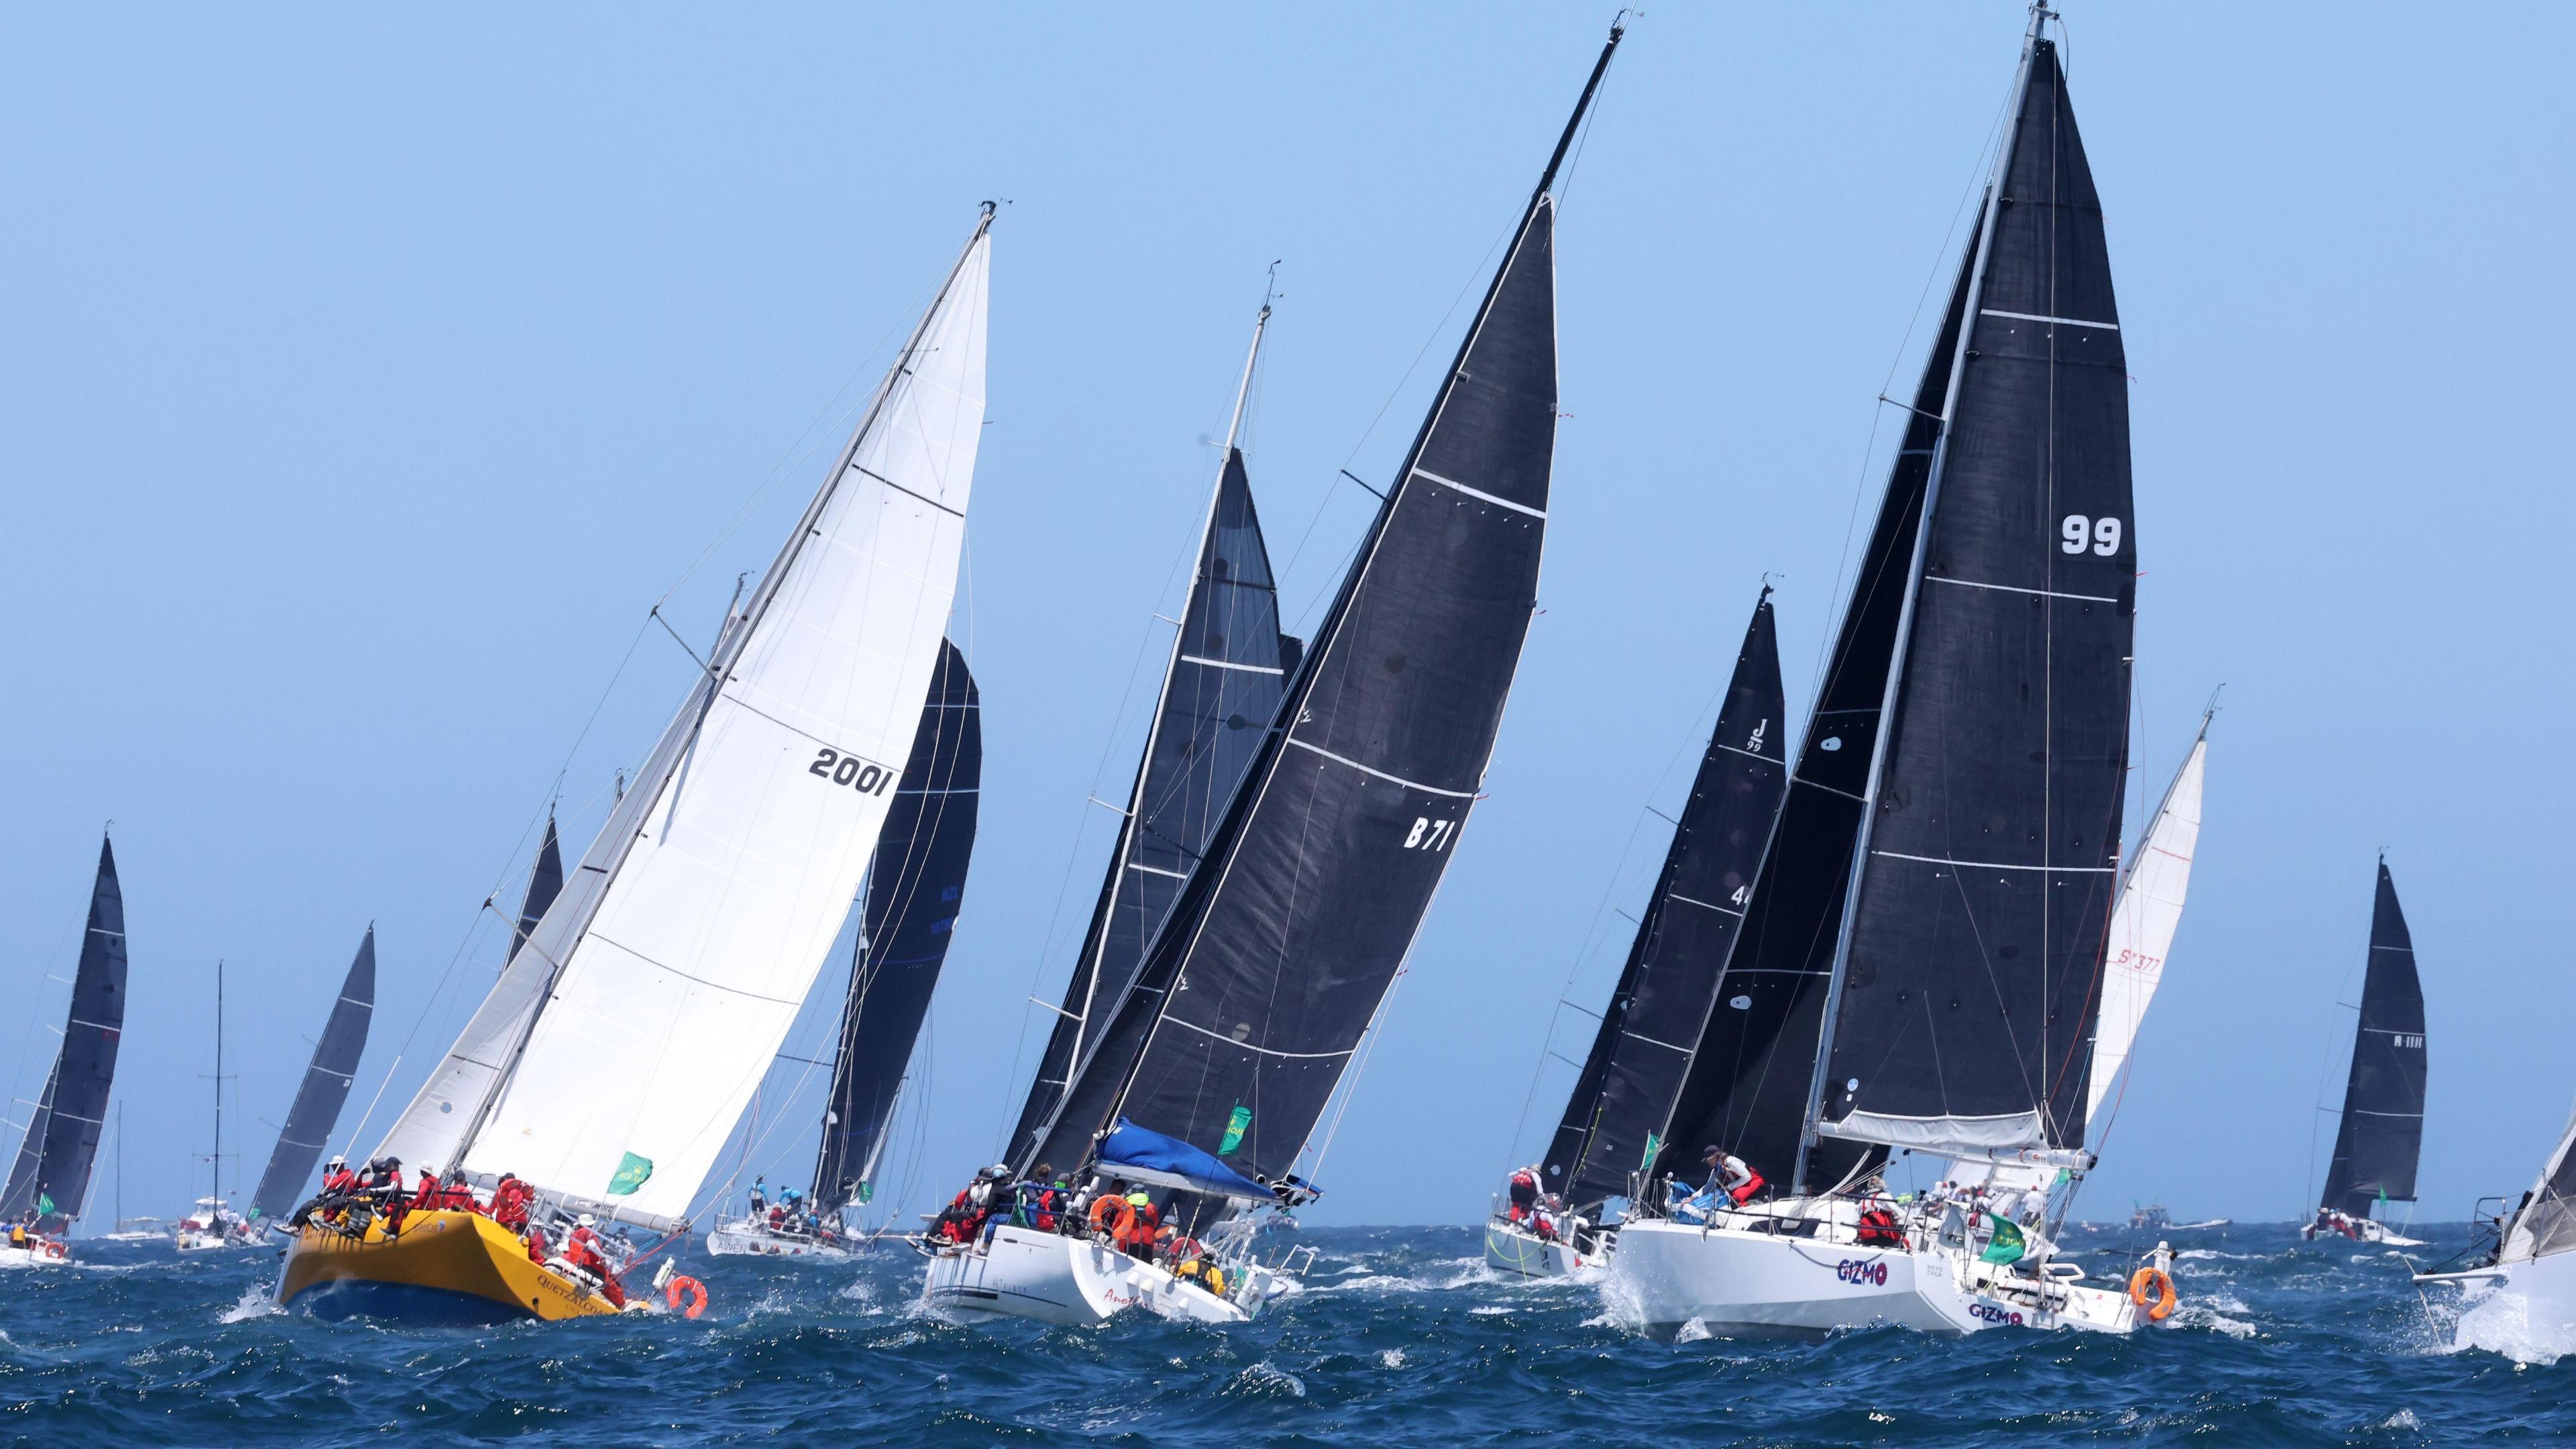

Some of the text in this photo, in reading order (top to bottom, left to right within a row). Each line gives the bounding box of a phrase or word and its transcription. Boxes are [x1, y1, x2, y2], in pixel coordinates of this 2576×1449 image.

[2061, 515, 2121, 557] 99
[1752, 718, 1768, 737] J
[1746, 740, 1762, 752] 99
[808, 748, 894, 797] 2001
[1837, 1258, 1888, 1287] GIZMO
[1968, 1303, 2023, 1326] GIZMO
